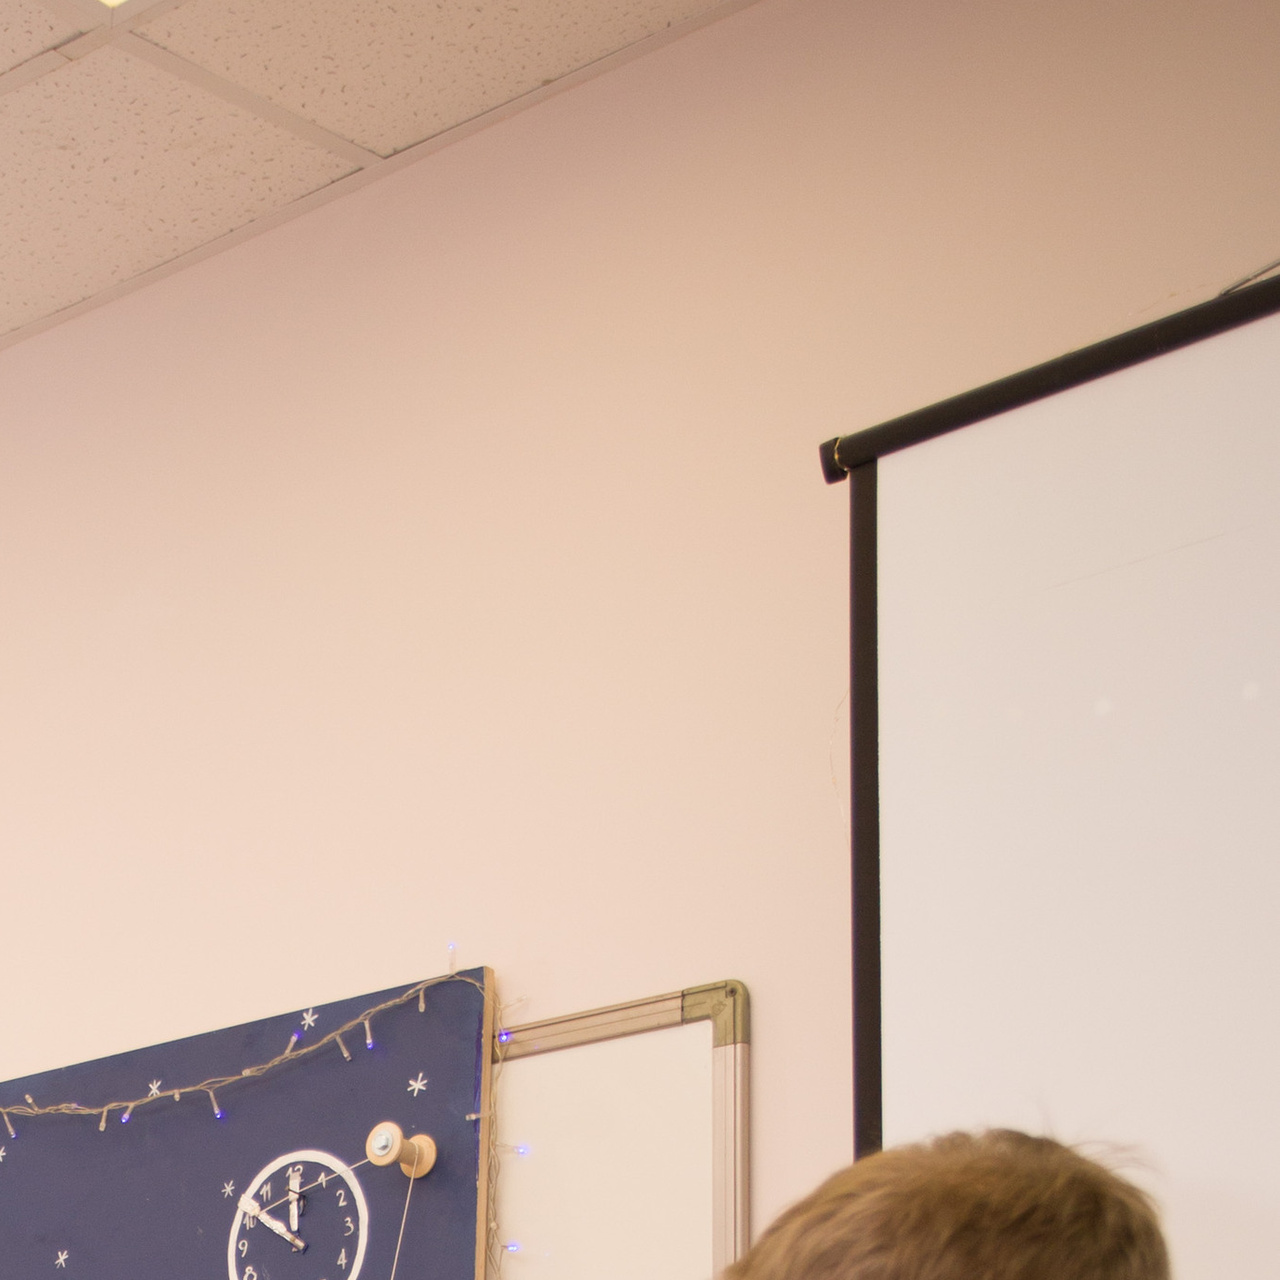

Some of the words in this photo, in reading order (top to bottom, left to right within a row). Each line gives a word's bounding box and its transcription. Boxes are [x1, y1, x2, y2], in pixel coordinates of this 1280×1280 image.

[259, 1182, 271, 1202] 11
[336, 1189, 347, 1206] 2
[344, 1217, 354, 1236] 3
[238, 1240, 248, 1258] 9
[337, 1248, 347, 1270] 4
